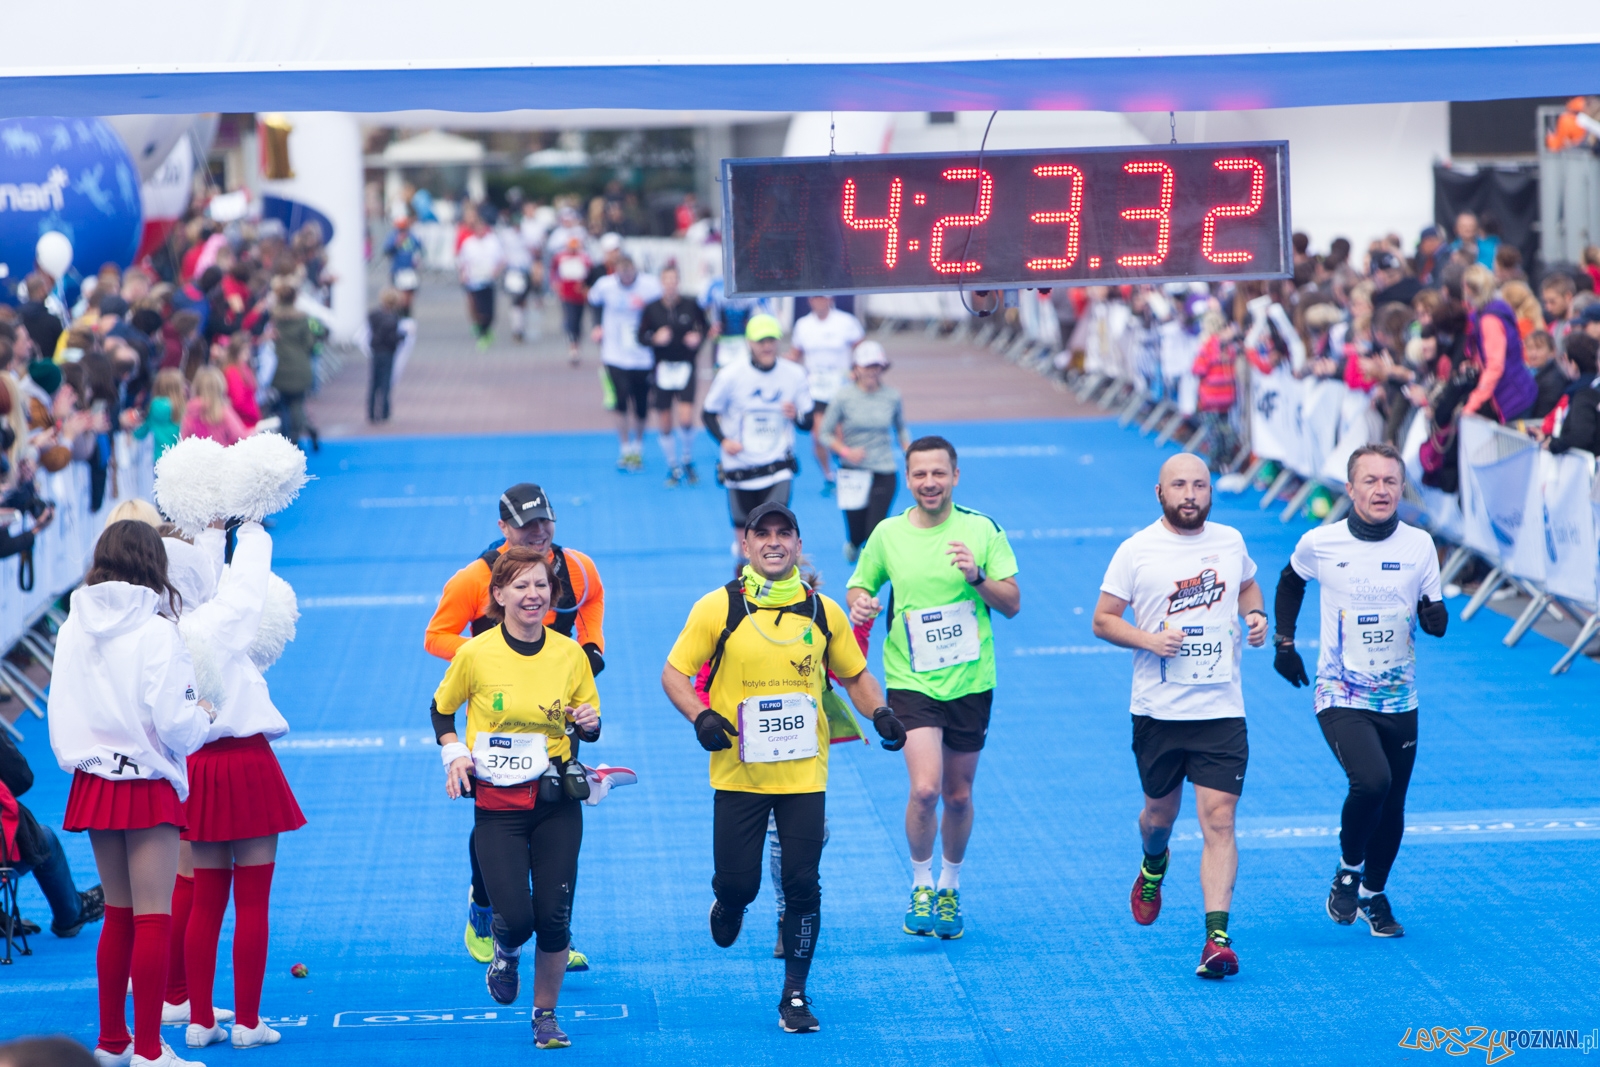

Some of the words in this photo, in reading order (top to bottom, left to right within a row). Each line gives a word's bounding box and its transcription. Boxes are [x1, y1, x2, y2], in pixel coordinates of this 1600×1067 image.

[1180, 577, 1202, 589] ULTRA
[1349, 576, 1370, 585] SIŁA
[1178, 584, 1204, 598] CROSS
[926, 624, 962, 642] 6158
[1362, 629, 1394, 645] 532
[1180, 641, 1222, 657] 5594
[768, 679, 780, 687] dla
[759, 715, 804, 732] 3368
[768, 734, 798, 743] Grzegorz
[487, 754, 533, 770] 3760
[491, 771, 527, 780] Agnieszka
